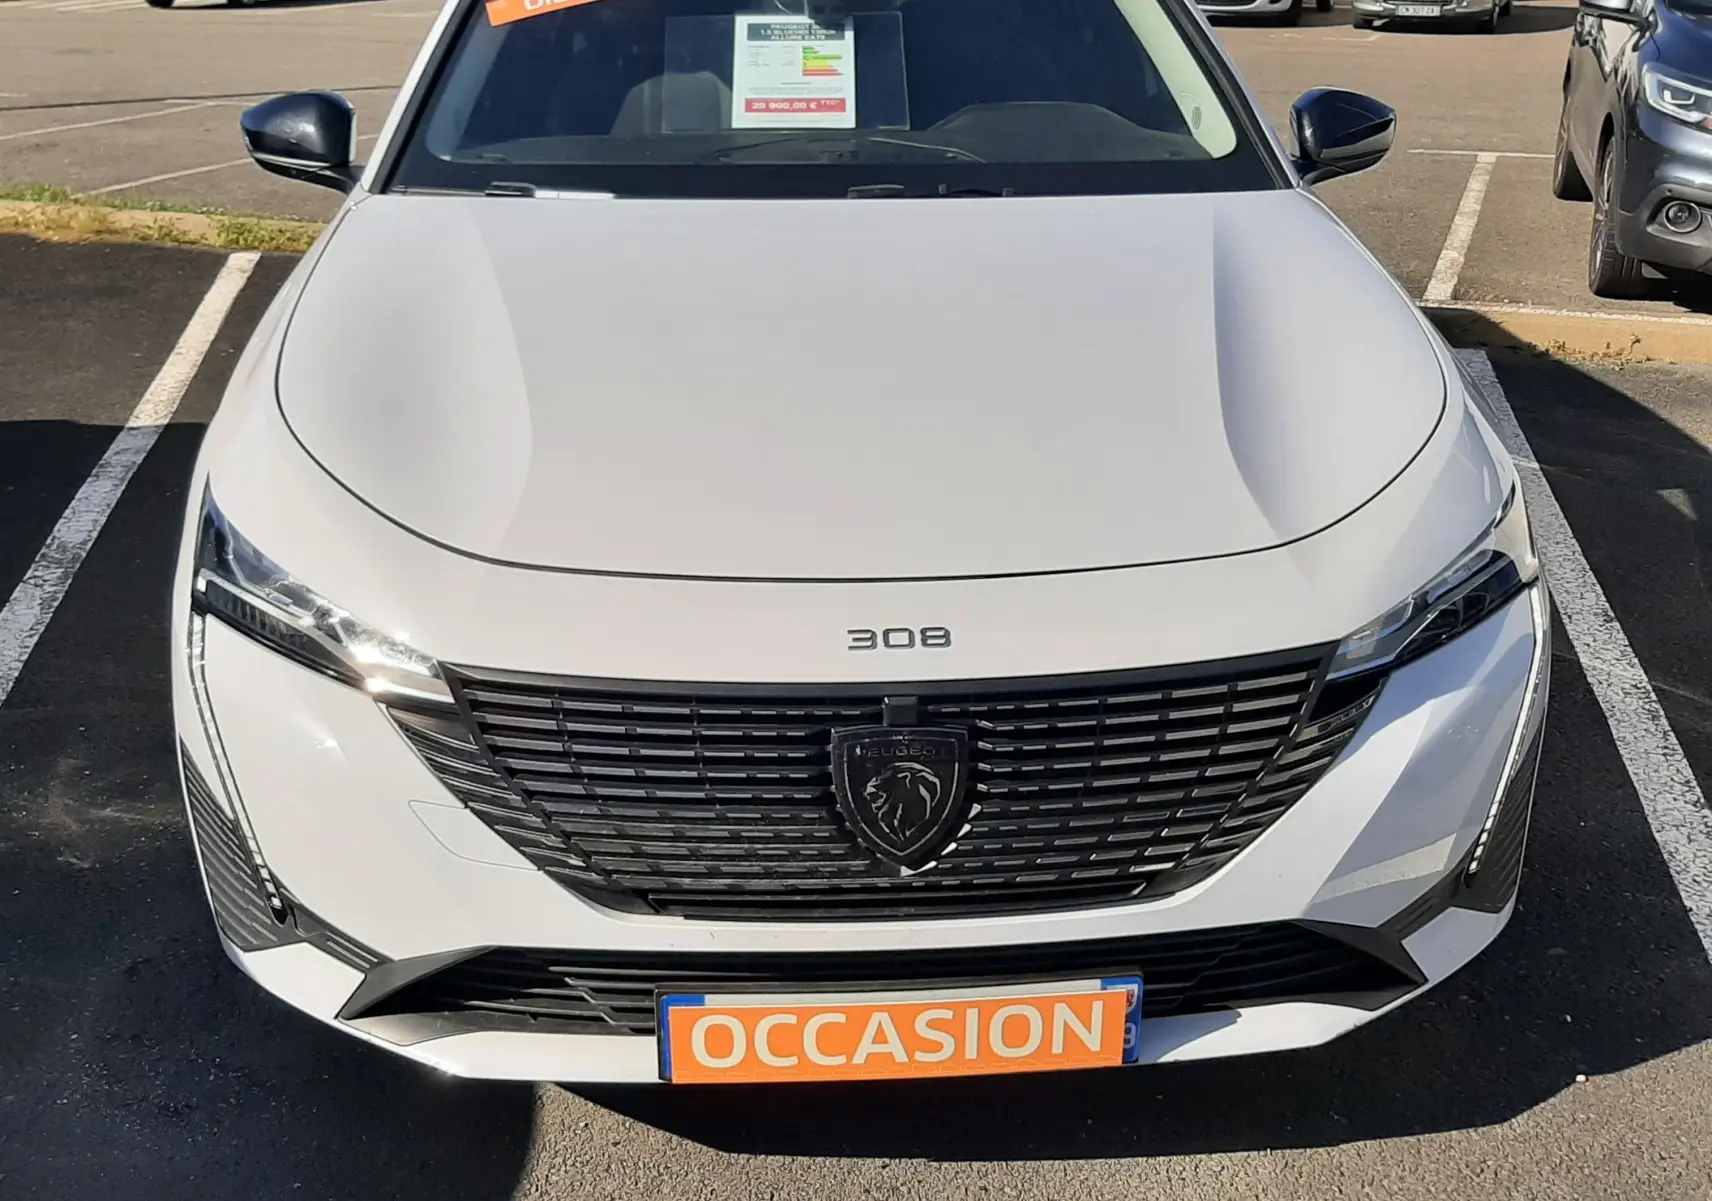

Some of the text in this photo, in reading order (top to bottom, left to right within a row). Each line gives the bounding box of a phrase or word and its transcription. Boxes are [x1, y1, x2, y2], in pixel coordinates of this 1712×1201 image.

[768, 102, 807, 110] 900,00
[847, 626, 952, 651] 308
[691, 1000, 1104, 1068] OCCASION
